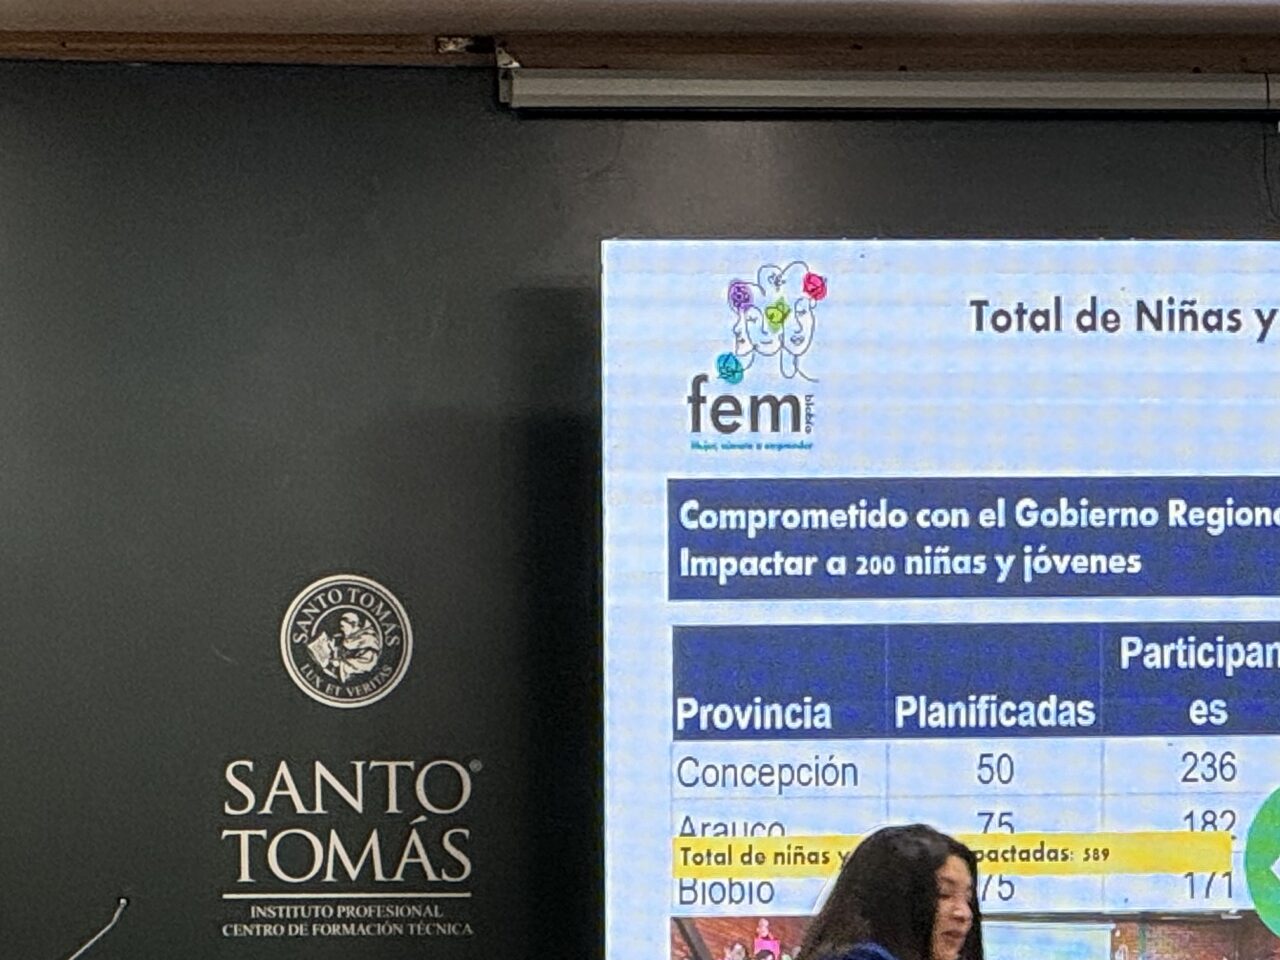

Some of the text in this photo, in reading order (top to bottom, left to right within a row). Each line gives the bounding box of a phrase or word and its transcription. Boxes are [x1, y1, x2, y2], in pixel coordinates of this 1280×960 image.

[969, 296, 1063, 333] Total
[1076, 296, 1121, 333] de
[1136, 296, 1242, 333] Niñas
[1254, 308, 1278, 343] y
[687, 373, 801, 434] fem
[680, 498, 908, 538] Comprometido
[916, 507, 971, 529] con
[979, 497, 1006, 528] el
[1015, 497, 1159, 528] Gobierno
[680, 545, 1142, 585] Impactar a 200 niñas y jóvenes
[293, 588, 343, 644] SANTO
[300, 664, 393, 697] LUX ET VERITAS
[676, 695, 1229, 730] Provincia Planificadas es
[224, 760, 473, 816] SANTO
[677, 751, 1237, 795] Concepción 50 236
[679, 810, 1237, 837] Arauco 75 182
[221, 815, 473, 884] TOMÁS
[680, 845, 732, 866] Total
[740, 845, 766, 866] de
[773, 843, 830, 866] niñas
[974, 841, 1075, 863] pactadas:
[1083, 848, 1110, 862] 589
[222, 920, 474, 937] CENTRO DE FORMACIÓN TÉCNICA
[250, 904, 444, 919] INSTITUTO PROFESIONAL
